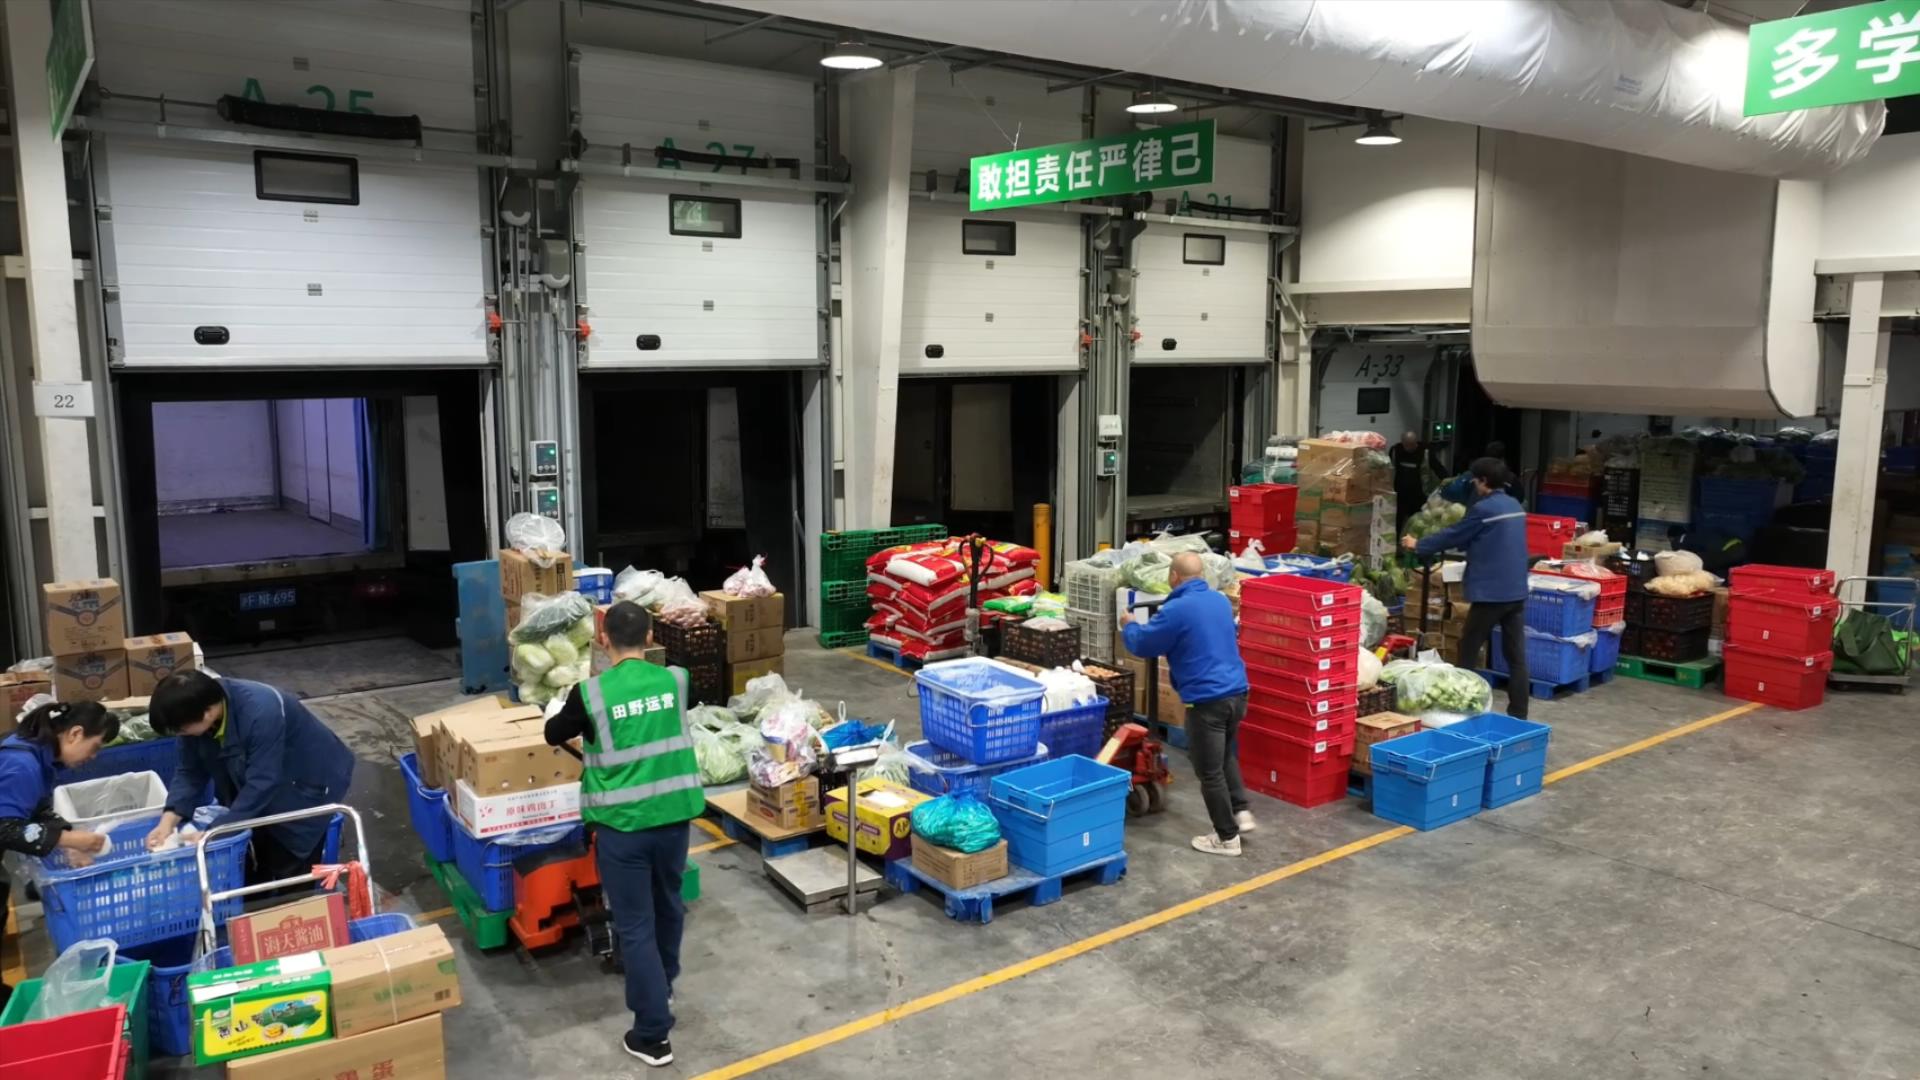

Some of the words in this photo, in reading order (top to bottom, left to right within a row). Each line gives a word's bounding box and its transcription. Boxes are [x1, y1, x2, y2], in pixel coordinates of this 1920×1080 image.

[1769, 11, 1920, 100] 多学
[977, 131, 1201, 203] 敢担责任严律己
[1354, 354, 1405, 377] A-33
[54, 394, 74, 408] 22
[612, 692, 675, 720] 田野运营
